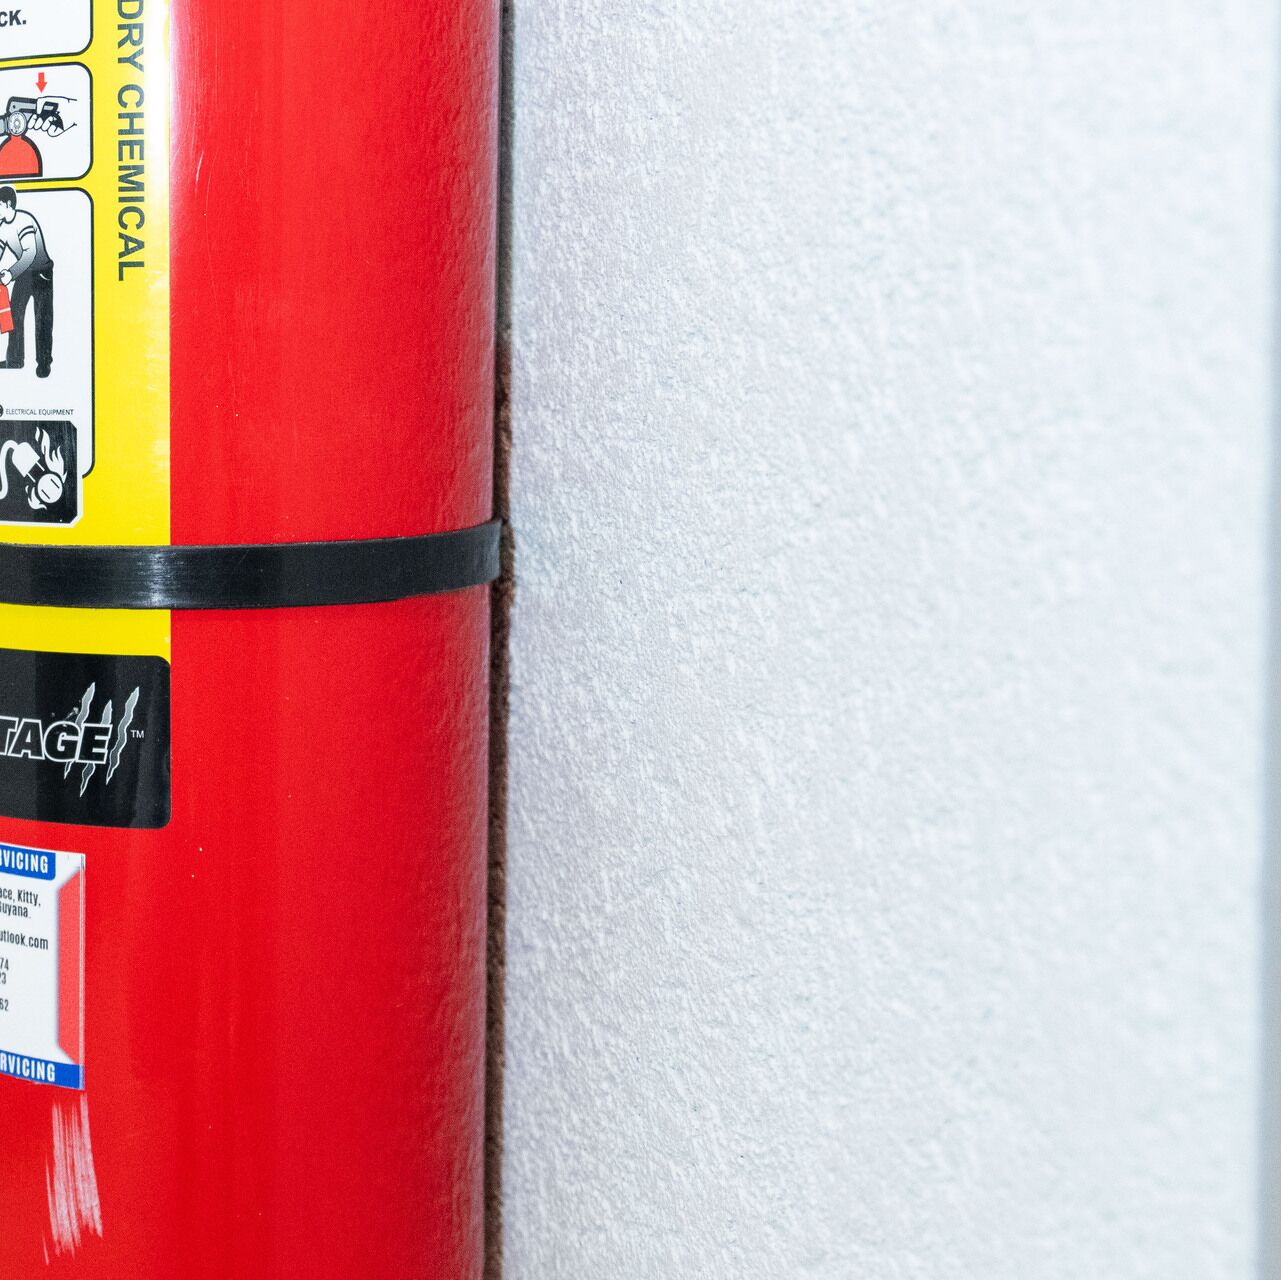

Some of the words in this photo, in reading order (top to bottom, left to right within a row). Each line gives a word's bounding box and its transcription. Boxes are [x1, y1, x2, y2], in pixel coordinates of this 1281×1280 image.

[117, 83, 146, 282] CHEMICAL
[5, 408, 37, 416] ELECTRICAL
[38, 408, 75, 416] EQUIPMENT
[17, 888, 42, 908] Kitty,
